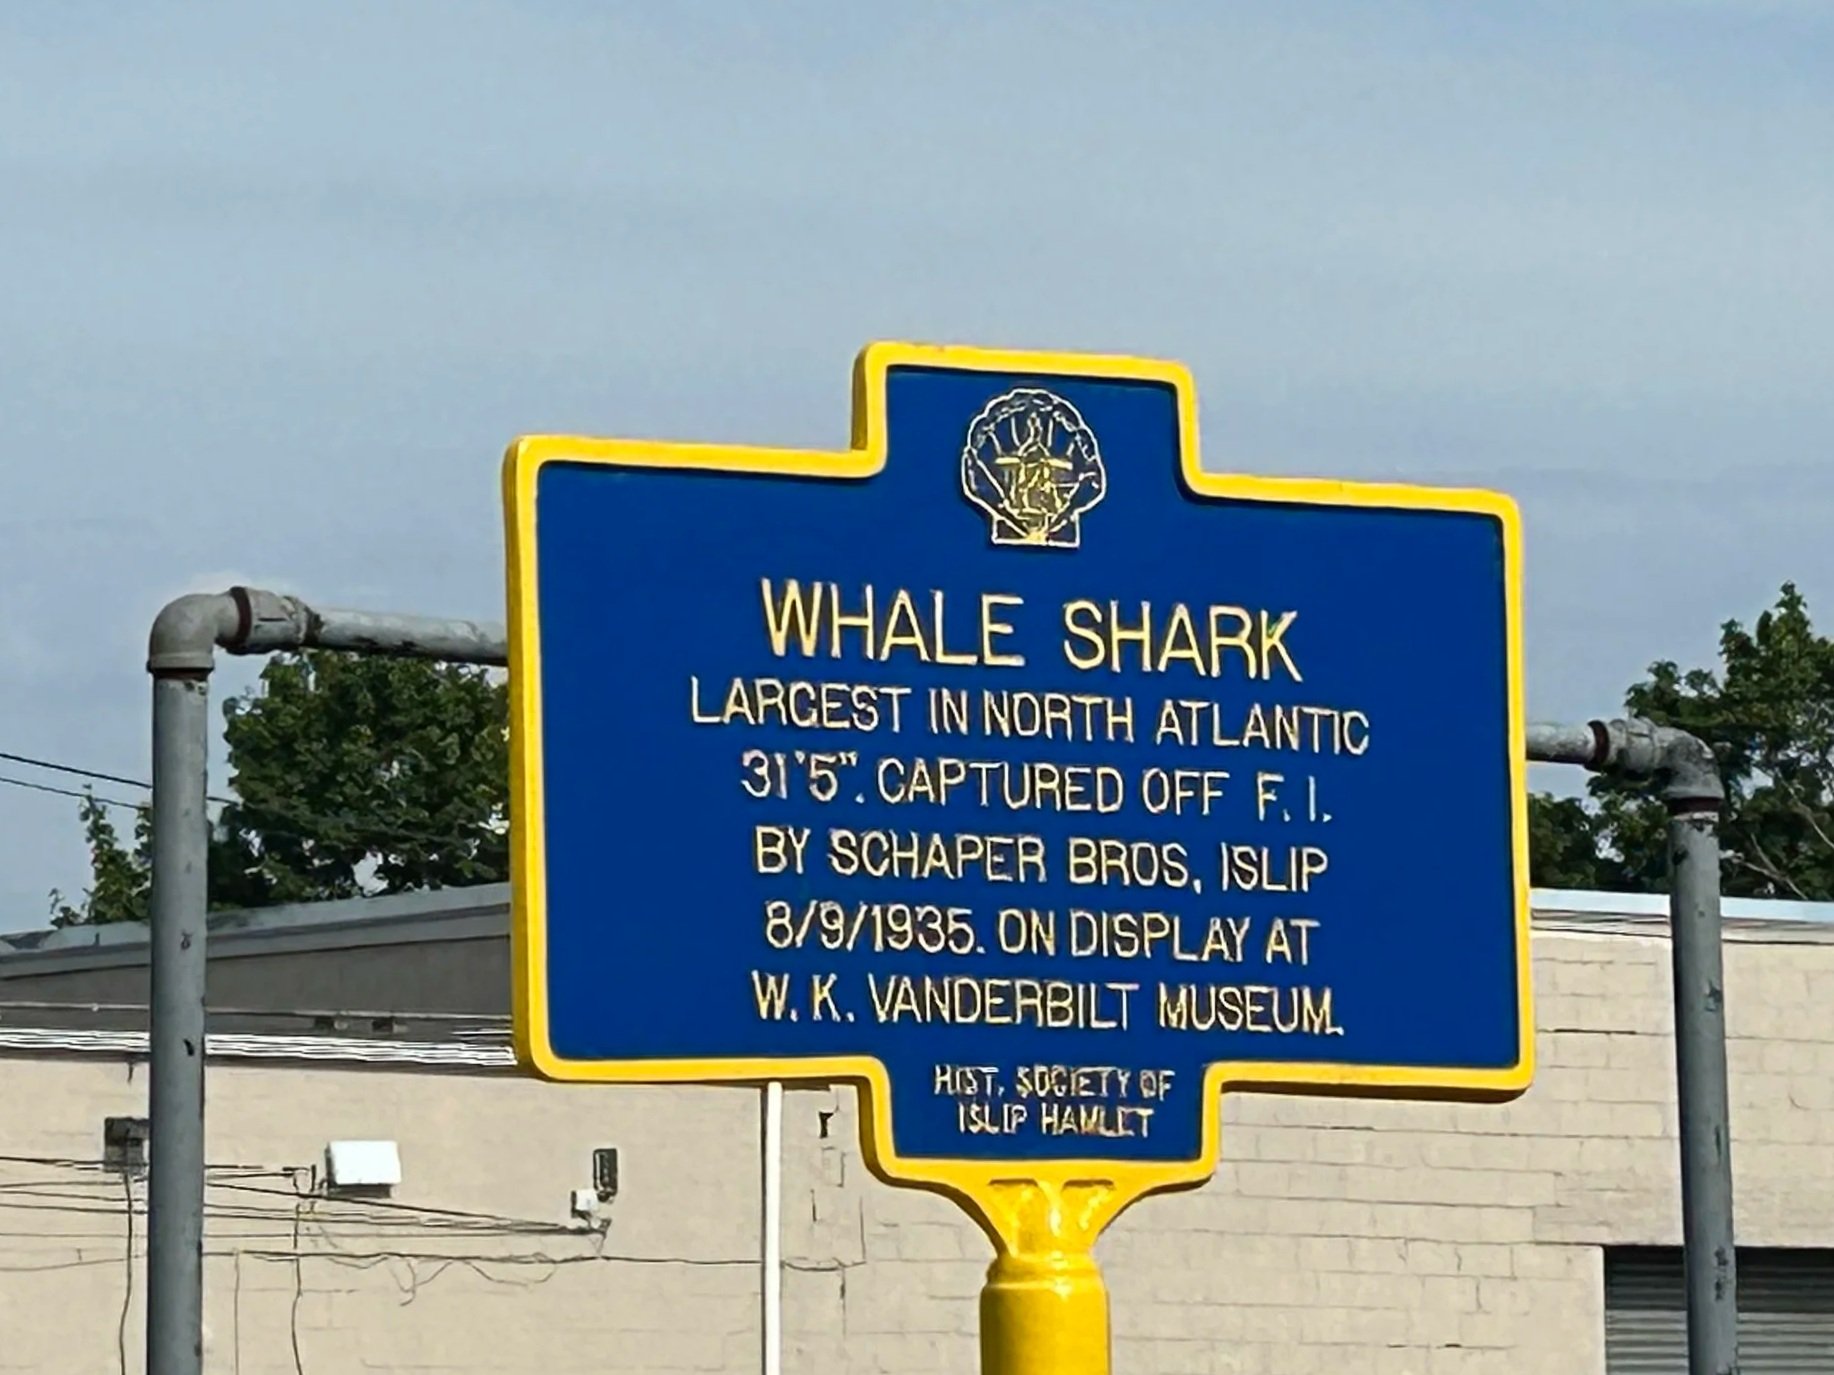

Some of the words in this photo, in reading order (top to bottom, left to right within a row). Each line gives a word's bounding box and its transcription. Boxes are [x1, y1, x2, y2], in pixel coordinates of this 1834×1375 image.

[761, 577, 1025, 668] WHALE
[1063, 599, 1303, 682] SHARK
[691, 676, 911, 733] LARGEST
[929, 688, 968, 735] IN
[983, 691, 1134, 743] NORTH
[1156, 699, 1369, 755] ATLANTIC
[877, 757, 1124, 814] CAPTURED
[1142, 767, 1230, 816] OFF
[1257, 771, 1291, 822] F.
[755, 825, 811, 874] BY
[827, 828, 1046, 883] SCHAPER
[1221, 842, 1328, 892] ISLIP
[766, 900, 985, 955] 8/9/1935.
[998, 908, 1055, 956] ON
[1070, 909, 1251, 962] DISPLAY
[1265, 918, 1320, 966] AT
[751, 969, 798, 1022] W.
[812, 973, 855, 1023] K.
[868, 973, 1140, 1031] VANDERBILT
[1159, 982, 1345, 1036] MUSEUM.
[1016, 1064, 1131, 1099] SOCIETY
[1139, 1069, 1175, 1101] OF
[959, 1102, 1028, 1135] ISLIP
[1041, 1102, 1155, 1138] HAMLET
